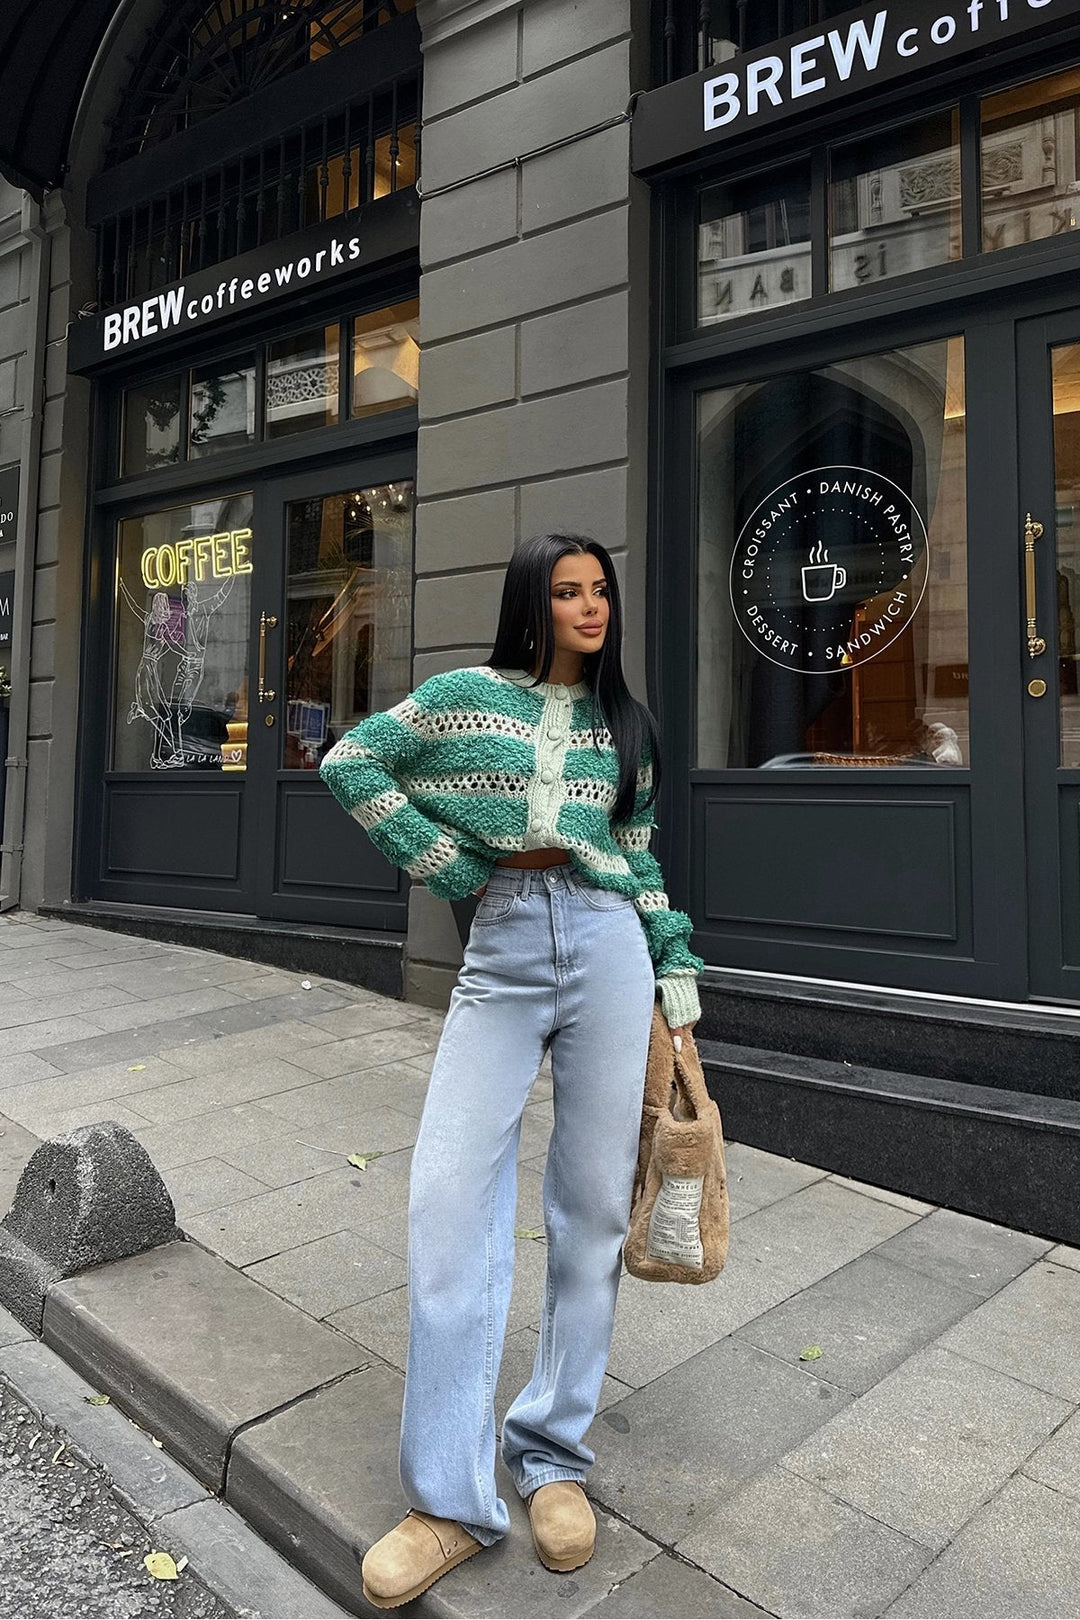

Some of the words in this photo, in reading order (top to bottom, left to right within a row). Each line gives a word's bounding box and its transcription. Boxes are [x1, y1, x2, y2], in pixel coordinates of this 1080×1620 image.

[703, 10, 887, 132] BREW
[896, 0, 1052, 57] coff
[103, 286, 185, 352] BREW
[186, 236, 361, 320] coffeeworks
[141, 528, 253, 589] COFFEE
[742, 492, 798, 579] CROISSANT
[819, 480, 883, 506] DANISH
[883, 504, 914, 564] PASTRY
[746, 604, 798, 656] DESSERT
[825, 591, 908, 660] SANDWICH
